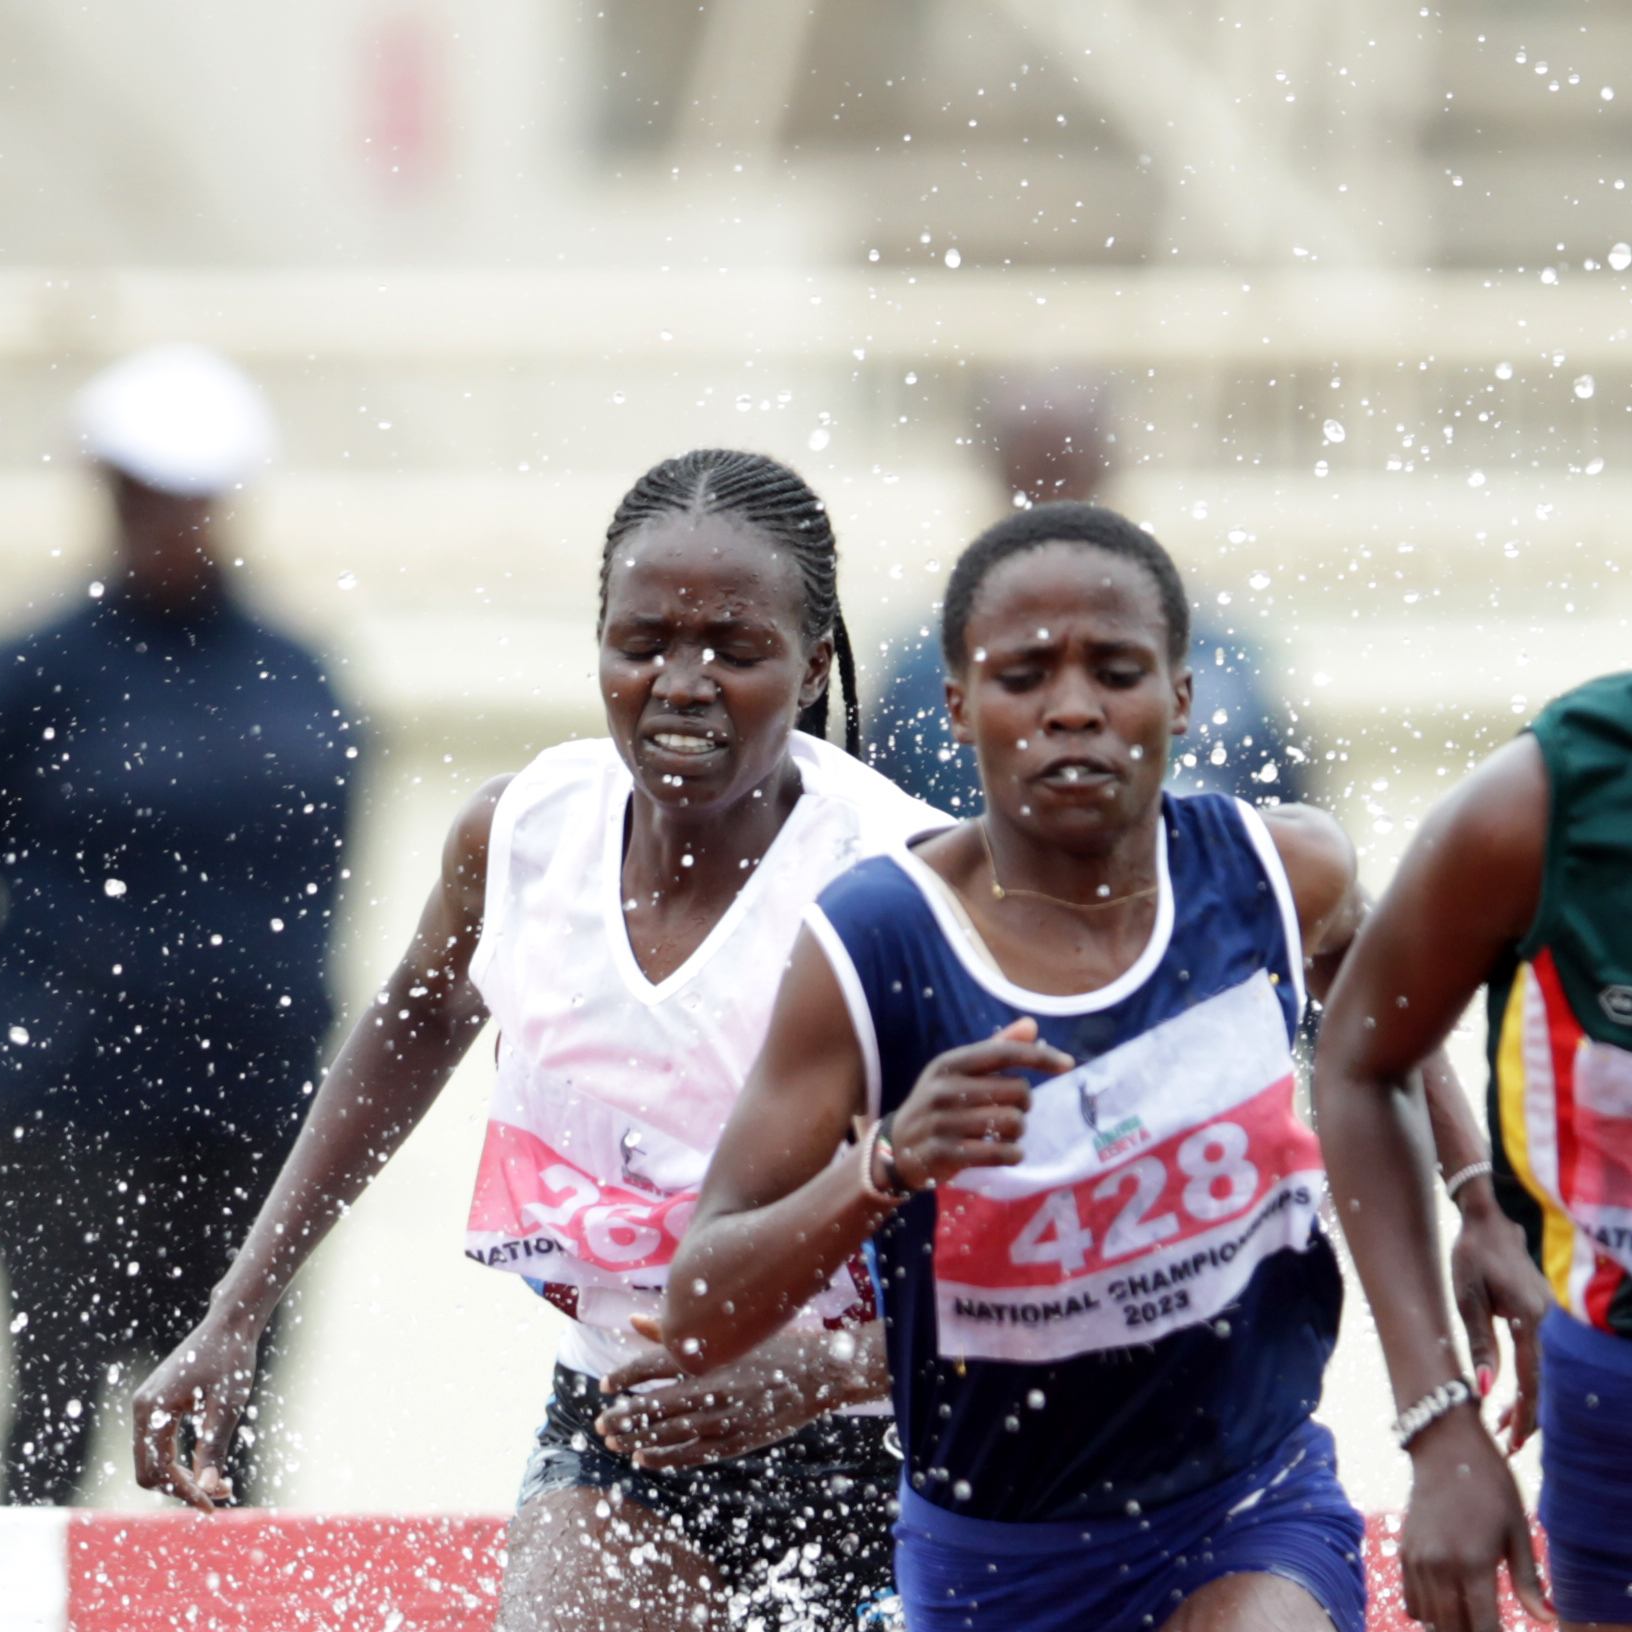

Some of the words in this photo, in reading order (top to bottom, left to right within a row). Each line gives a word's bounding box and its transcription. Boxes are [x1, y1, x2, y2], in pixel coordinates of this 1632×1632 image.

[1009, 1122, 1259, 1274] 428
[955, 1291, 1100, 1324] NATIONAL
[1123, 1289, 1190, 1326] 2023
